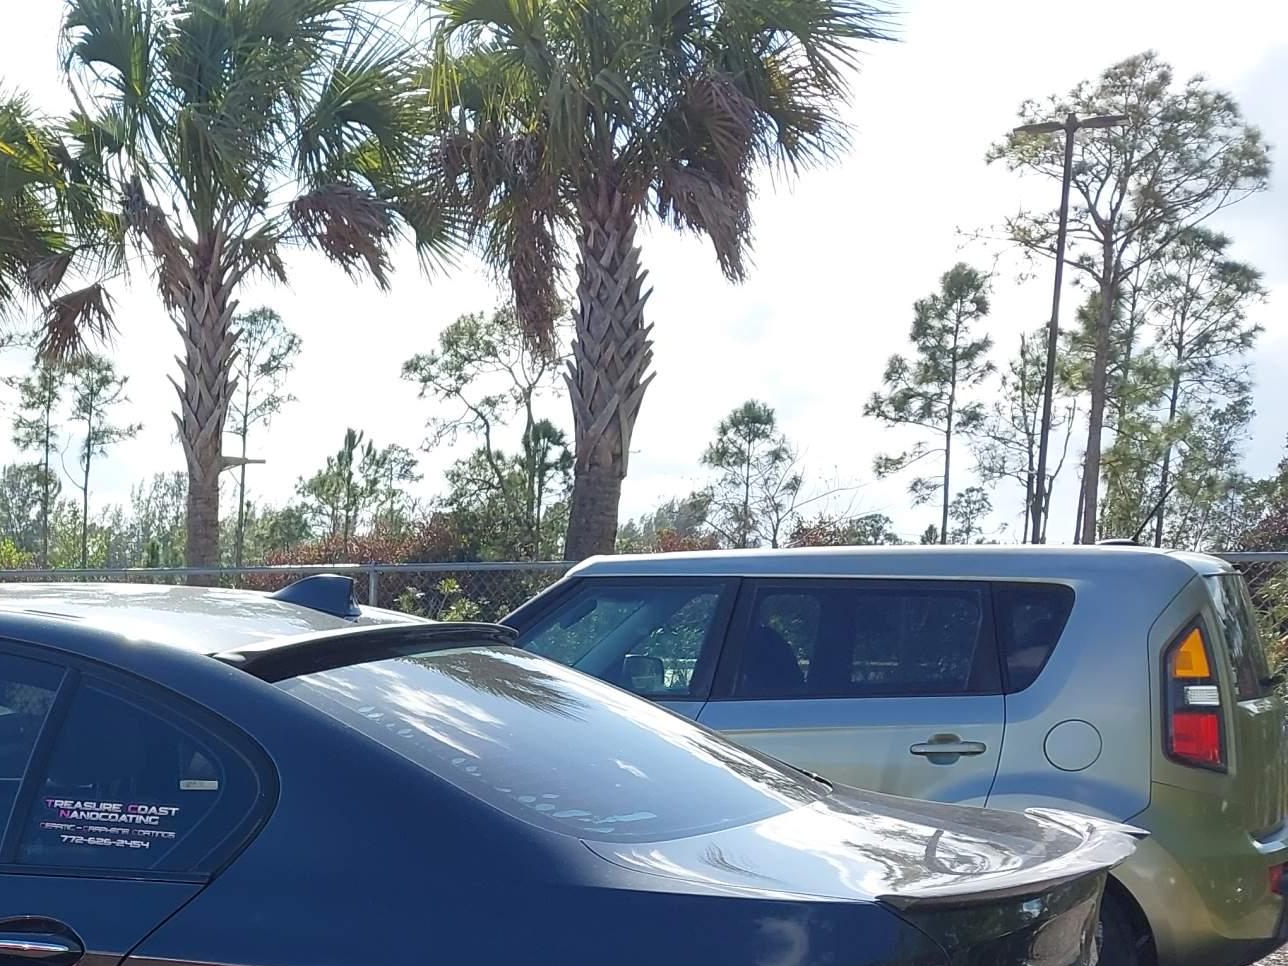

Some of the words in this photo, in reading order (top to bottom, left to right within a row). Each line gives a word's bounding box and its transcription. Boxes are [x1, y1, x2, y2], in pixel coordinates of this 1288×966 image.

[46, 799, 122, 813] TREASURE
[127, 804, 179, 816] COAST
[59, 809, 159, 825] NANOCOATING
